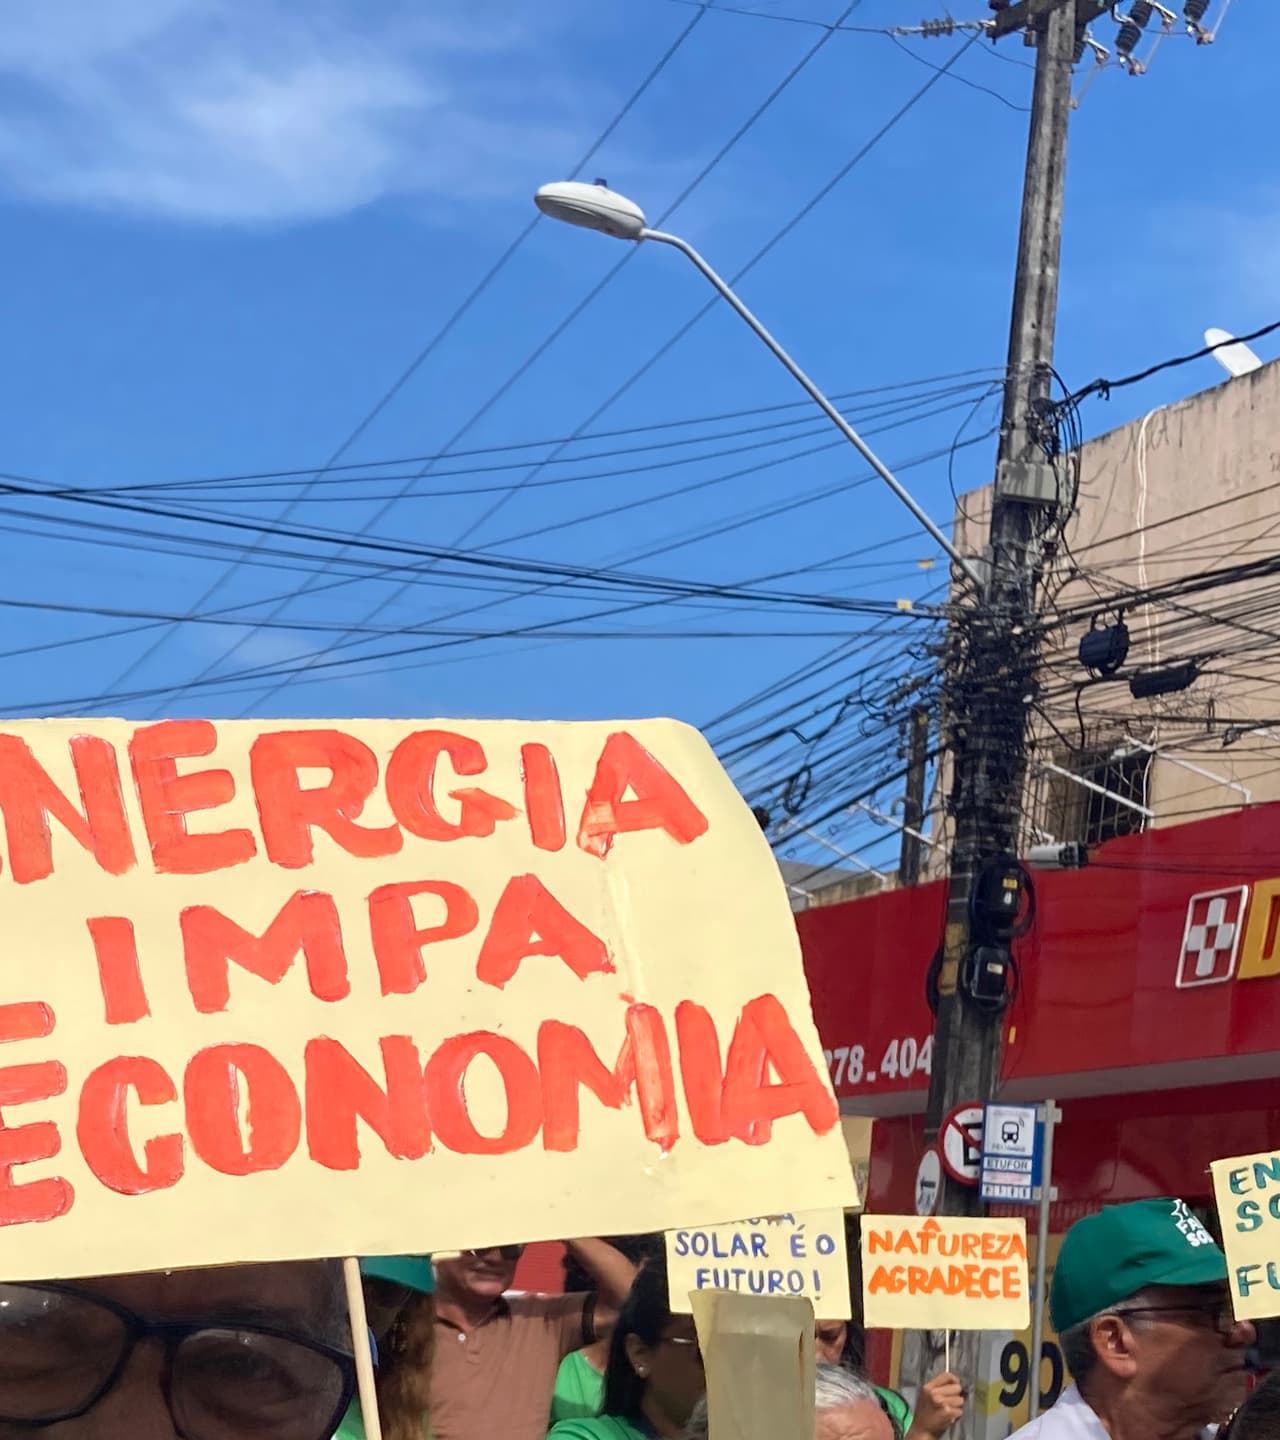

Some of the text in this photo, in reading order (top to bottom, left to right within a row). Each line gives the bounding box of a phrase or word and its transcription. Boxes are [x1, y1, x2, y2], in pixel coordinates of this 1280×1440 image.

[675, 1224, 836, 1258] SOLAR É O
[867, 1228, 1028, 1262] NATUREZA
[867, 1263, 1022, 1299] AGRADECE
